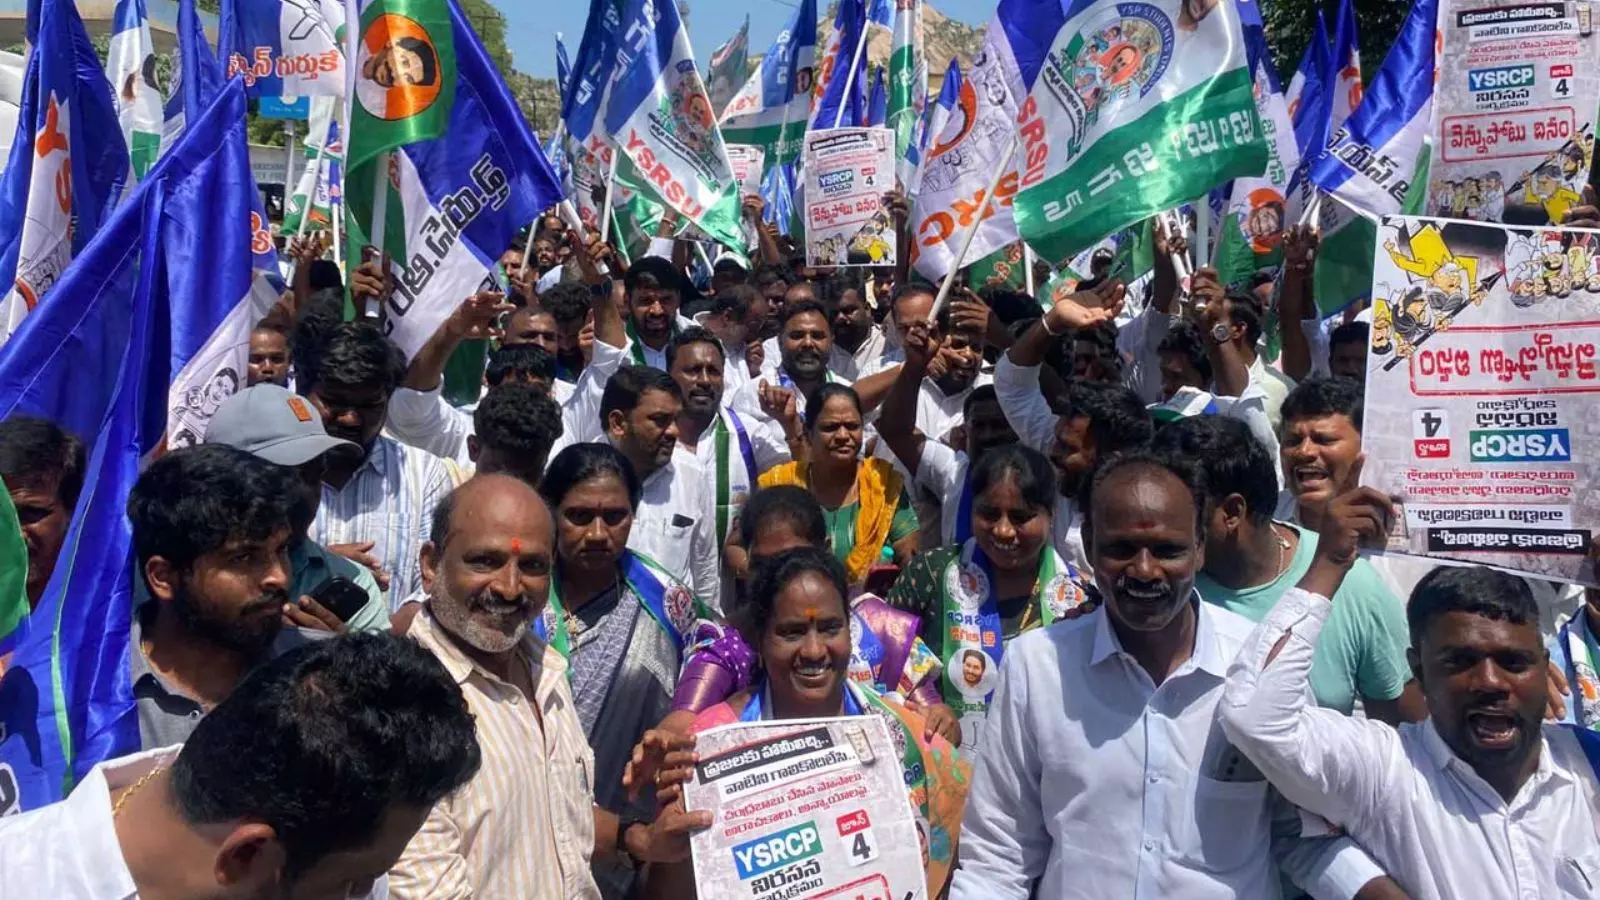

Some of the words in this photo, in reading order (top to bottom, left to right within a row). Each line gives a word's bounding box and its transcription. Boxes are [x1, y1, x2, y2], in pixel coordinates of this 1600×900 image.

[275, 50, 341, 81] గుర్తుకే
[1470, 68, 1533, 90] YSRCP
[1556, 79, 1569, 96] 4
[1451, 119, 1526, 154] వెన్నుపోటు
[1534, 117, 1570, 140] దినం
[627, 128, 704, 218] YSRSU
[820, 171, 853, 185] YSRCP
[866, 176, 874, 186] 4
[1419, 347, 1470, 382] దినం
[1480, 333, 1597, 383] వెన్నుపోటు
[1421, 412, 1442, 437] 4
[1476, 412, 1558, 428] నిరసన
[1418, 440, 1448, 456] జూన్
[1472, 433, 1567, 457] YSRCP
[1462, 485, 1492, 496] చేసిన
[1495, 485, 1571, 497] చంద్రబాబు
[1508, 508, 1563, 521] వాటిని
[1512, 533, 1583, 547] ప్రజలకు
[703, 752, 761, 778] ప్రజలకు
[725, 775, 770, 795] వాటిని
[724, 795, 785, 821] చంద్రబాబు
[787, 785, 816, 802] చేసిన
[840, 816, 868, 832] జూన్
[735, 826, 819, 873] YSRCP
[852, 832, 871, 860] 4
[751, 858, 822, 896] నిరసన
